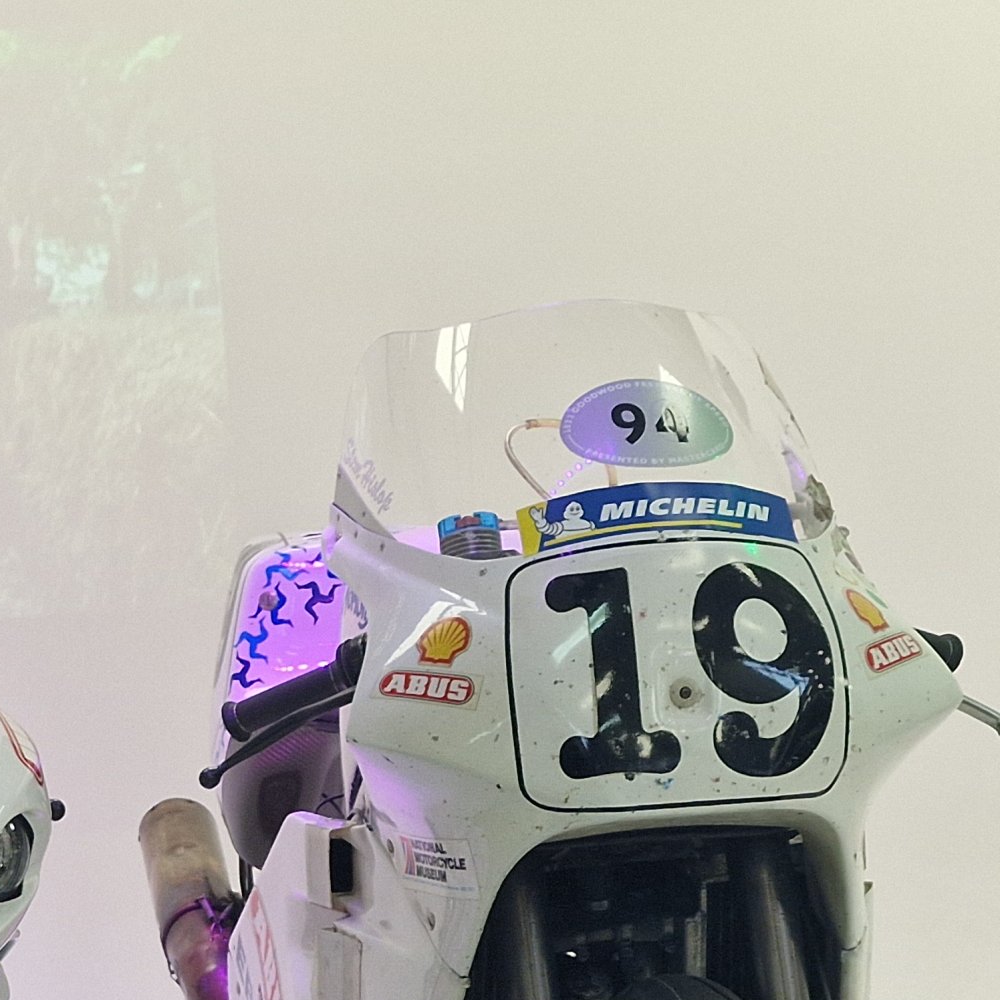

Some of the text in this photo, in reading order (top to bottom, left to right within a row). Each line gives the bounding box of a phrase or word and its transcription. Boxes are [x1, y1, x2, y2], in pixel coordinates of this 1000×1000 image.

[600, 497, 771, 523] MICHELIN
[871, 633, 920, 671] ABUS
[544, 561, 835, 780] 19
[384, 674, 470, 702] ABUS
[413, 851, 467, 871] MOTORCYCLE
[416, 865, 448, 883] MUSEUM
